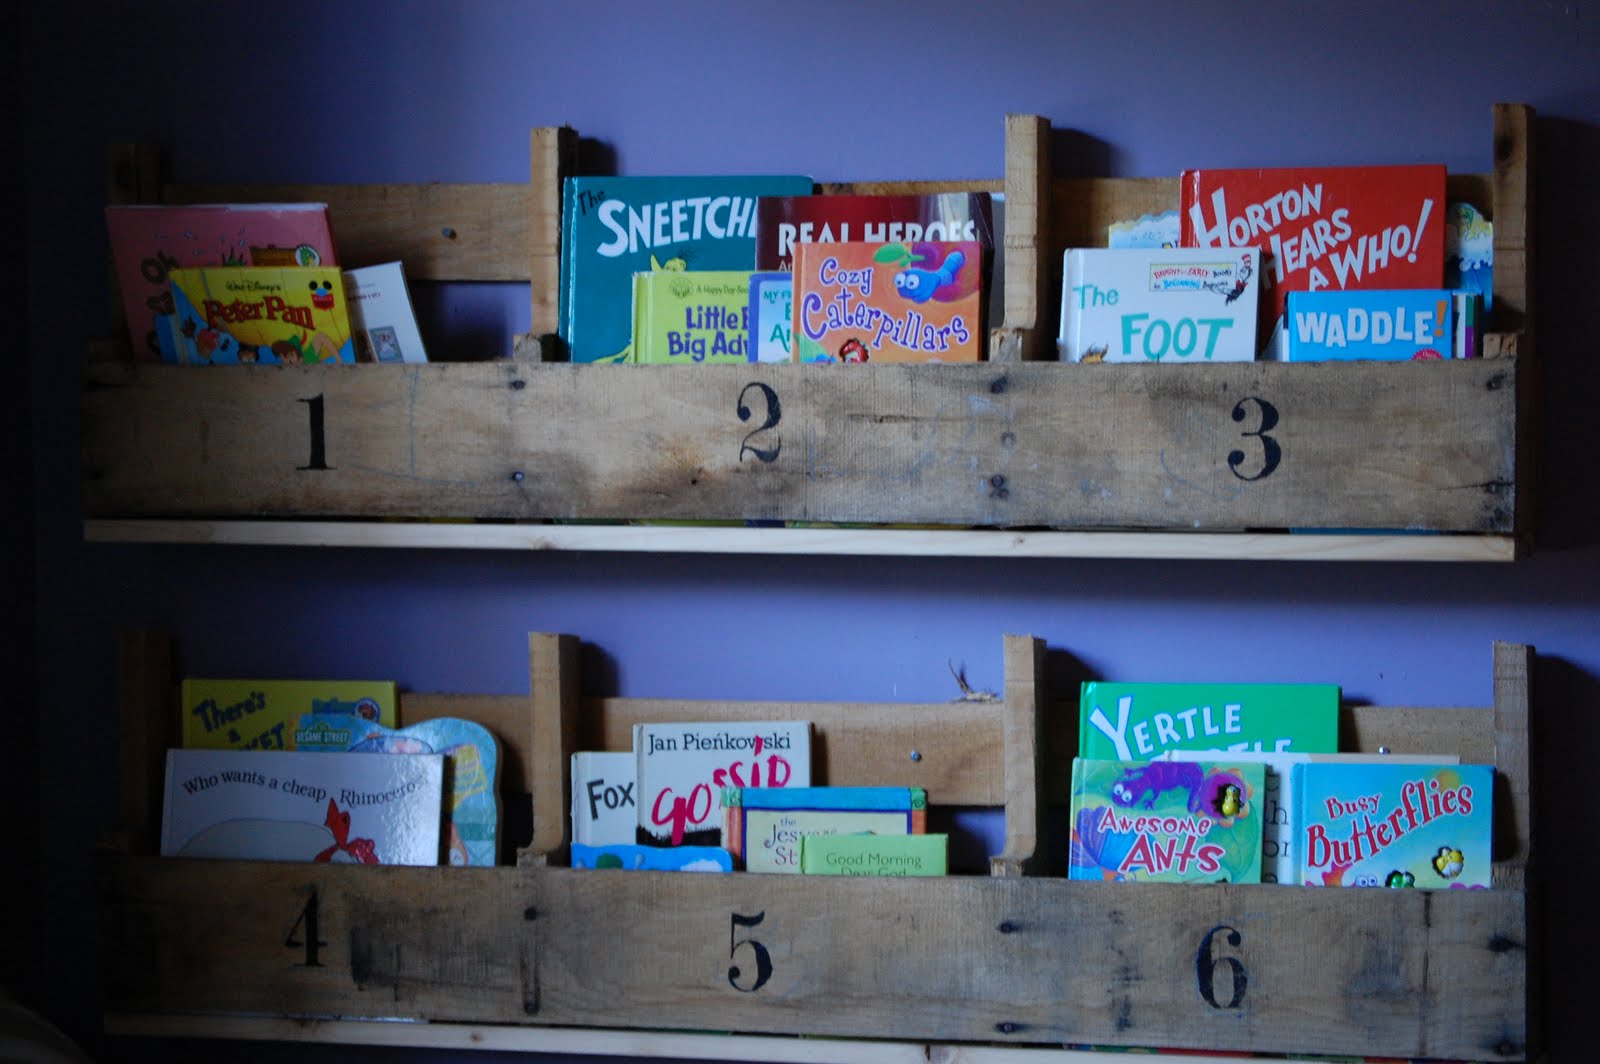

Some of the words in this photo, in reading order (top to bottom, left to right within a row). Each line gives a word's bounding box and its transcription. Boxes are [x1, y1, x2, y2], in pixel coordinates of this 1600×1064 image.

[578, 190, 606, 217] The
[1188, 182, 1323, 248] HORTON
[1258, 207, 1352, 288] HEARS
[1308, 265, 1330, 291] A
[1328, 198, 1435, 290] WHO!
[820, 257, 874, 296] Cozy
[1072, 283, 1120, 310] The
[204, 298, 264, 329] Peter
[263, 295, 316, 331] Pan
[685, 304, 739, 330] Little
[802, 288, 970, 350] Caterpillars
[1120, 312, 1235, 360] FOOT
[1295, 299, 1448, 348] WADDLE!
[667, 331, 706, 362] Big
[296, 392, 338, 471] 1
[737, 382, 782, 463] 2
[1227, 397, 1282, 481] 3
[295, 729, 323, 744] SESAME
[323, 730, 349, 743] STREET
[648, 734, 677, 755] Jan
[1088, 695, 1242, 761] YERTLE
[181, 776, 219, 796] Who
[221, 771, 266, 787] wants
[269, 778, 278, 790] a
[282, 779, 328, 803] cheap
[586, 778, 635, 821] Fox
[1325, 793, 1381, 820] Busy
[780, 817, 797, 828] the
[1306, 780, 1473, 868] Butterflies
[826, 853, 864, 866] Good
[868, 852, 922, 869] Morning
[284, 886, 328, 968] 4
[728, 910, 773, 993] 5
[1196, 926, 1248, 1009] 6
